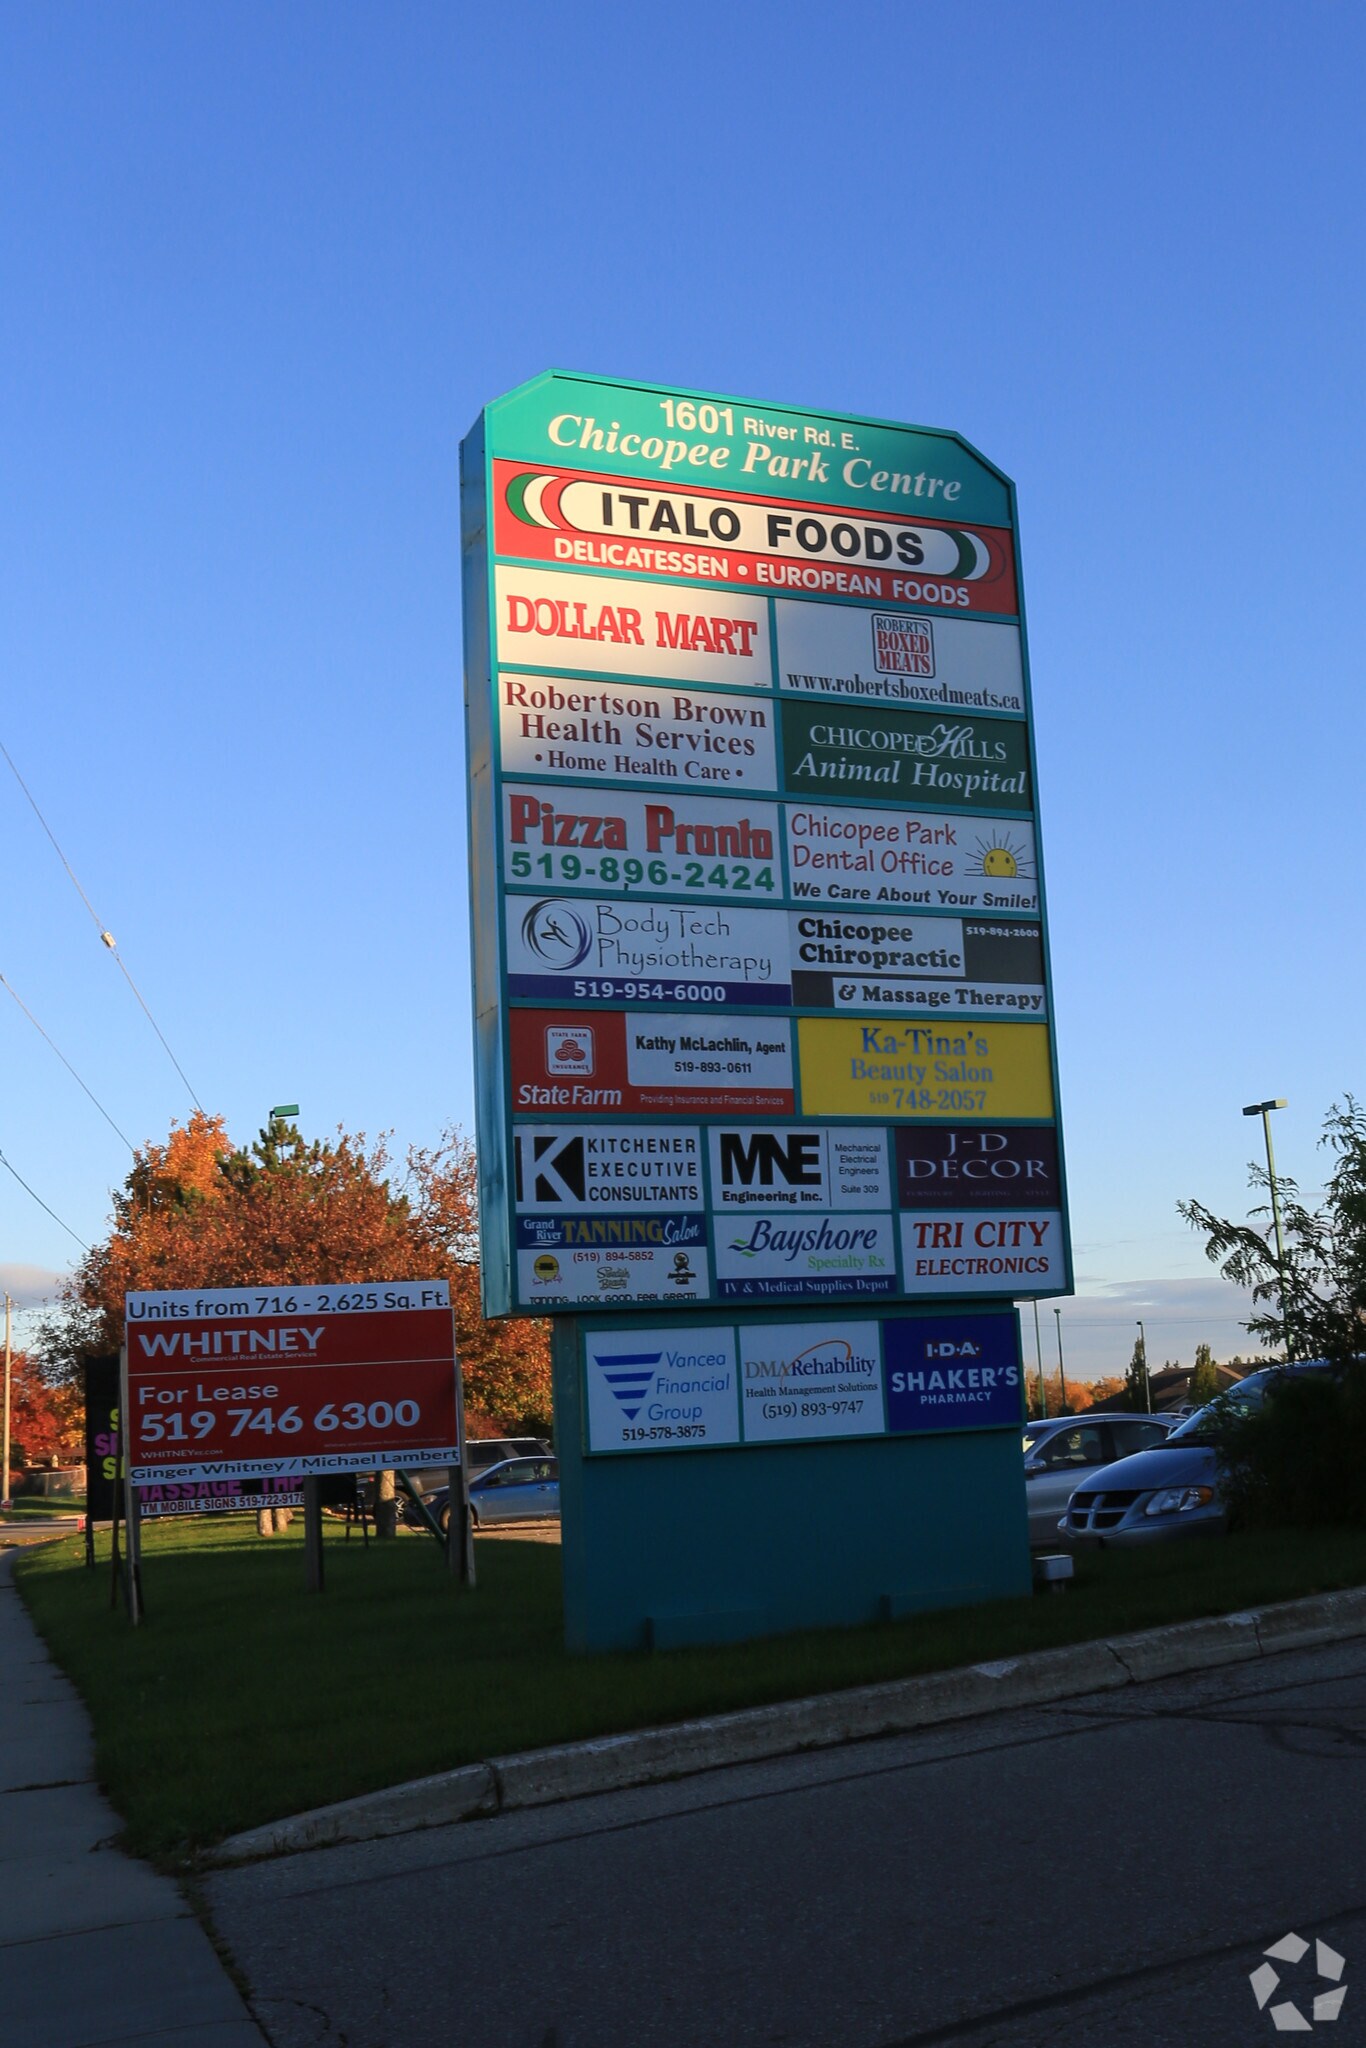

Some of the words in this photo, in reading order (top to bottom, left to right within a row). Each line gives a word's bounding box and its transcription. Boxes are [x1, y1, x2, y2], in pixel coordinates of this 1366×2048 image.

[659, 399, 735, 436] 1601
[743, 417, 800, 441] River
[803, 426, 837, 448] Rd.
[841, 432, 860, 451] E.
[547, 413, 729, 471] Chicopee
[740, 441, 830, 483] Park
[843, 459, 962, 501] Centre
[601, 492, 741, 541] ITALO
[767, 513, 925, 565] FOODS
[554, 536, 729, 578] DELICATESSEN
[756, 562, 882, 597] EUROPEAN
[892, 579, 970, 607] FOODS
[506, 594, 645, 645] DOLLAR
[655, 611, 757, 657] MART
[876, 617, 929, 636] ROBERT'S
[877, 631, 930, 654] BOXED
[878, 650, 931, 674] MEATS
[787, 673, 1021, 710] www.robertsboxedmeats.ca
[503, 681, 661, 719] Robertson
[672, 696, 767, 728] Brown
[519, 712, 622, 746] Health
[635, 722, 755, 756] Services
[809, 725, 935, 756] CHICOPEE
[931, 723, 1007, 760] HILLS
[548, 750, 607, 772] Home
[614, 755, 678, 777] Health
[684, 760, 731, 780] Care
[792, 752, 900, 784] Animal
[911, 762, 1026, 797] Hospital
[509, 794, 628, 851] Pizza
[644, 804, 774, 860] Pronto
[791, 813, 899, 848] Chicopee
[906, 821, 957, 846] Park
[511, 851, 775, 892] 519-896-2424
[793, 844, 875, 872] Dental
[880, 850, 954, 876] Office
[793, 882, 821, 898] We
[827, 884, 871, 900] Care
[877, 887, 931, 903] About
[938, 890, 977, 906] Your
[983, 892, 1037, 909] Smile!
[798, 917, 913, 945] Chicopee
[966, 926, 1039, 938] 519-894-2600
[596, 937, 772, 981] Physiotherapy
[799, 943, 961, 969] Chiropractic
[574, 981, 727, 1002] 519-954-6000
[838, 984, 857, 1001] &
[862, 985, 951, 1007] Massage
[955, 988, 1043, 1010] Therapy
[636, 1035, 676, 1055] Kathy
[679, 1037, 752, 1055] McLachlin,
[756, 1042, 786, 1054] Agent
[861, 1027, 989, 1057] Ka-Tina's
[674, 1061, 752, 1074] 519-893-0611
[851, 1058, 927, 1085] Beauty
[934, 1060, 993, 1082] Salon
[640, 1093, 674, 1105] Providing
[675, 1094, 708, 1104] Insurance
[710, 1095, 723, 1104] and
[724, 1095, 754, 1105] Financial
[755, 1096, 784, 1105] Services
[869, 1092, 889, 1104] 519
[893, 1088, 987, 1110] 748-2057
[587, 1138, 696, 1153] KITCHENER
[835, 1143, 881, 1152] Mechanical
[588, 1162, 697, 1177] EXECUTIVE
[720, 1133, 822, 1186] MNE
[839, 1166, 879, 1176] Engineers
[840, 1155, 877, 1164] Electrical
[907, 1159, 1049, 1179] DECOR
[588, 1185, 699, 1201] CONSULTANTS
[722, 1191, 797, 1204] Engineering
[801, 1191, 823, 1202] Inc.
[841, 1184, 861, 1194] Suite
[863, 1184, 879, 1194] 309
[523, 1219, 555, 1230] Grand
[561, 1220, 664, 1243] TANNING
[661, 1215, 700, 1246] Salon
[536, 1229, 563, 1240] River
[744, 1218, 878, 1261] Bayshore
[913, 1222, 964, 1249] TRI
[974, 1220, 1050, 1248] CITY
[573, 1252, 601, 1264] (519)
[605, 1251, 654, 1262] 894-5852
[808, 1255, 865, 1271] Specialty
[868, 1256, 886, 1268] Rx
[915, 1256, 1049, 1276] ELECTRONICS
[743, 1282, 753, 1293] &
[758, 1280, 803, 1293] Medical
[806, 1279, 854, 1294] Supplies
[856, 1279, 889, 1292] Depot
[128, 1299, 190, 1319] Units
[195, 1299, 250, 1317] from
[255, 1296, 298, 1314] 716
[317, 1293, 378, 1315] 2,625
[383, 1291, 416, 1310] Sq.
[421, 1290, 449, 1308] Ft.
[138, 1326, 326, 1357] WHITNEY
[190, 1354, 239, 1364] Commercial
[240, 1354, 258, 1362] Real
[258, 1352, 284, 1361] Estate
[284, 1351, 318, 1360] Services
[666, 1351, 727, 1368] Vancea
[656, 1373, 731, 1395] Financial
[745, 1387, 777, 1398] Health
[779, 1384, 836, 1397] Management
[838, 1382, 878, 1393] Solutions
[891, 1366, 1019, 1393] SHAKER'S
[138, 1386, 188, 1405] For
[196, 1384, 280, 1403] Lease
[920, 1391, 992, 1405] PHARMACY
[139, 1411, 217, 1443] 519
[226, 1405, 304, 1438] 746
[313, 1399, 422, 1433] 6300
[647, 1403, 703, 1422] Group
[762, 1401, 798, 1420] (519)
[801, 1400, 864, 1417] 893-9747
[622, 1425, 706, 1441] 519-578-3875
[130, 1466, 197, 1481] Ginger
[201, 1460, 285, 1476] Whitney
[301, 1453, 377, 1468] Michael
[381, 1449, 460, 1465] Lambert
[141, 1503, 158, 1514] TM
[161, 1500, 202, 1513] MOBILE
[204, 1497, 237, 1510] SIGNS
